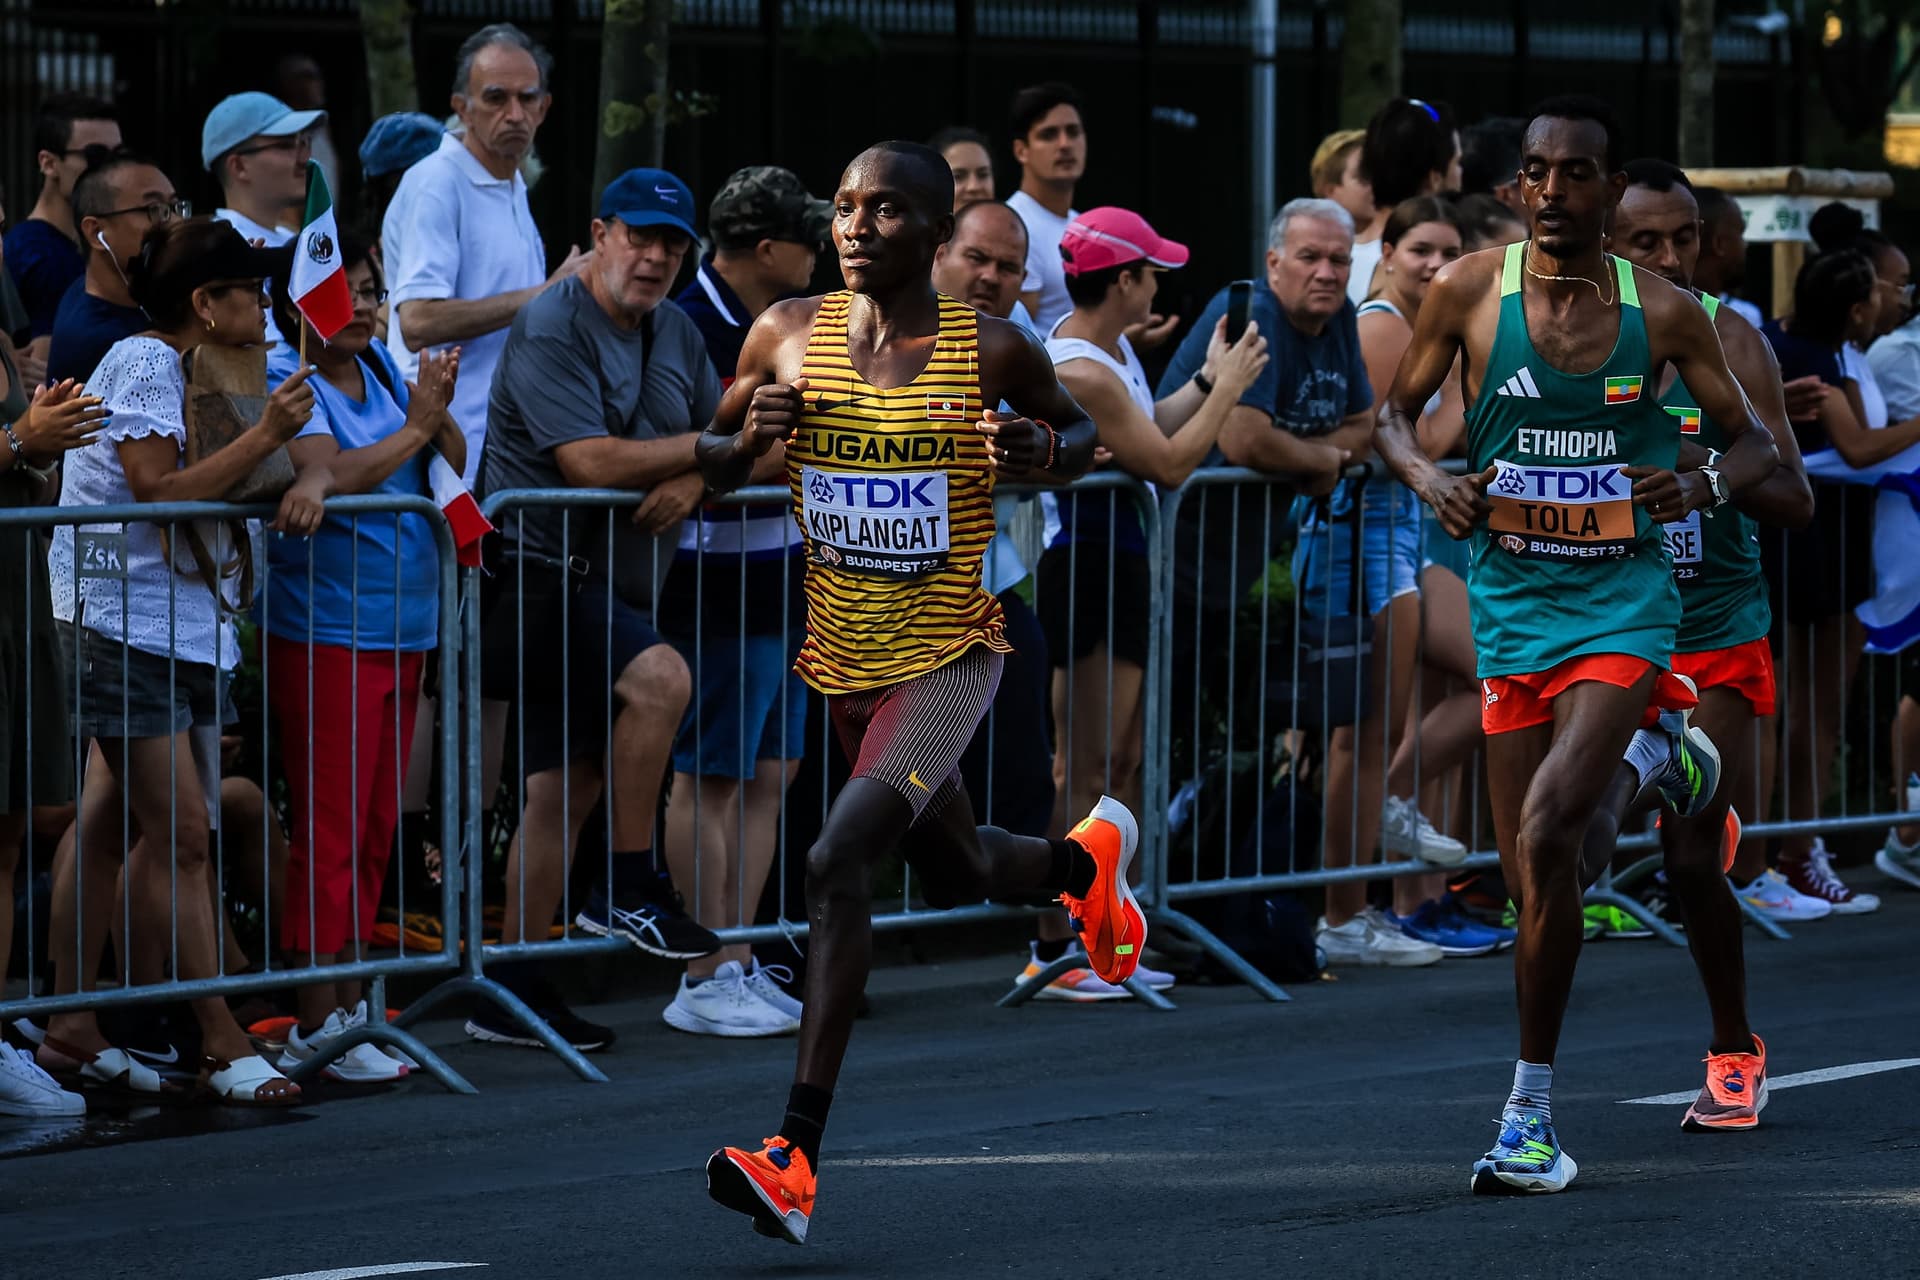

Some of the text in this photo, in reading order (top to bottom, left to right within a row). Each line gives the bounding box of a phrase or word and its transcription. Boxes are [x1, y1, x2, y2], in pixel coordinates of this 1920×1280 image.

[812, 432, 957, 464] UGANDA
[1518, 428, 1617, 458] ETHIOPIA
[832, 477, 936, 509] TDK
[1525, 468, 1621, 499] TDK
[809, 509, 941, 551] KIPLANGAT
[1519, 503, 1601, 537] TOLA
[845, 555, 921, 574] BUDAPEST
[1530, 541, 1625, 558] BUDAPEST 23
